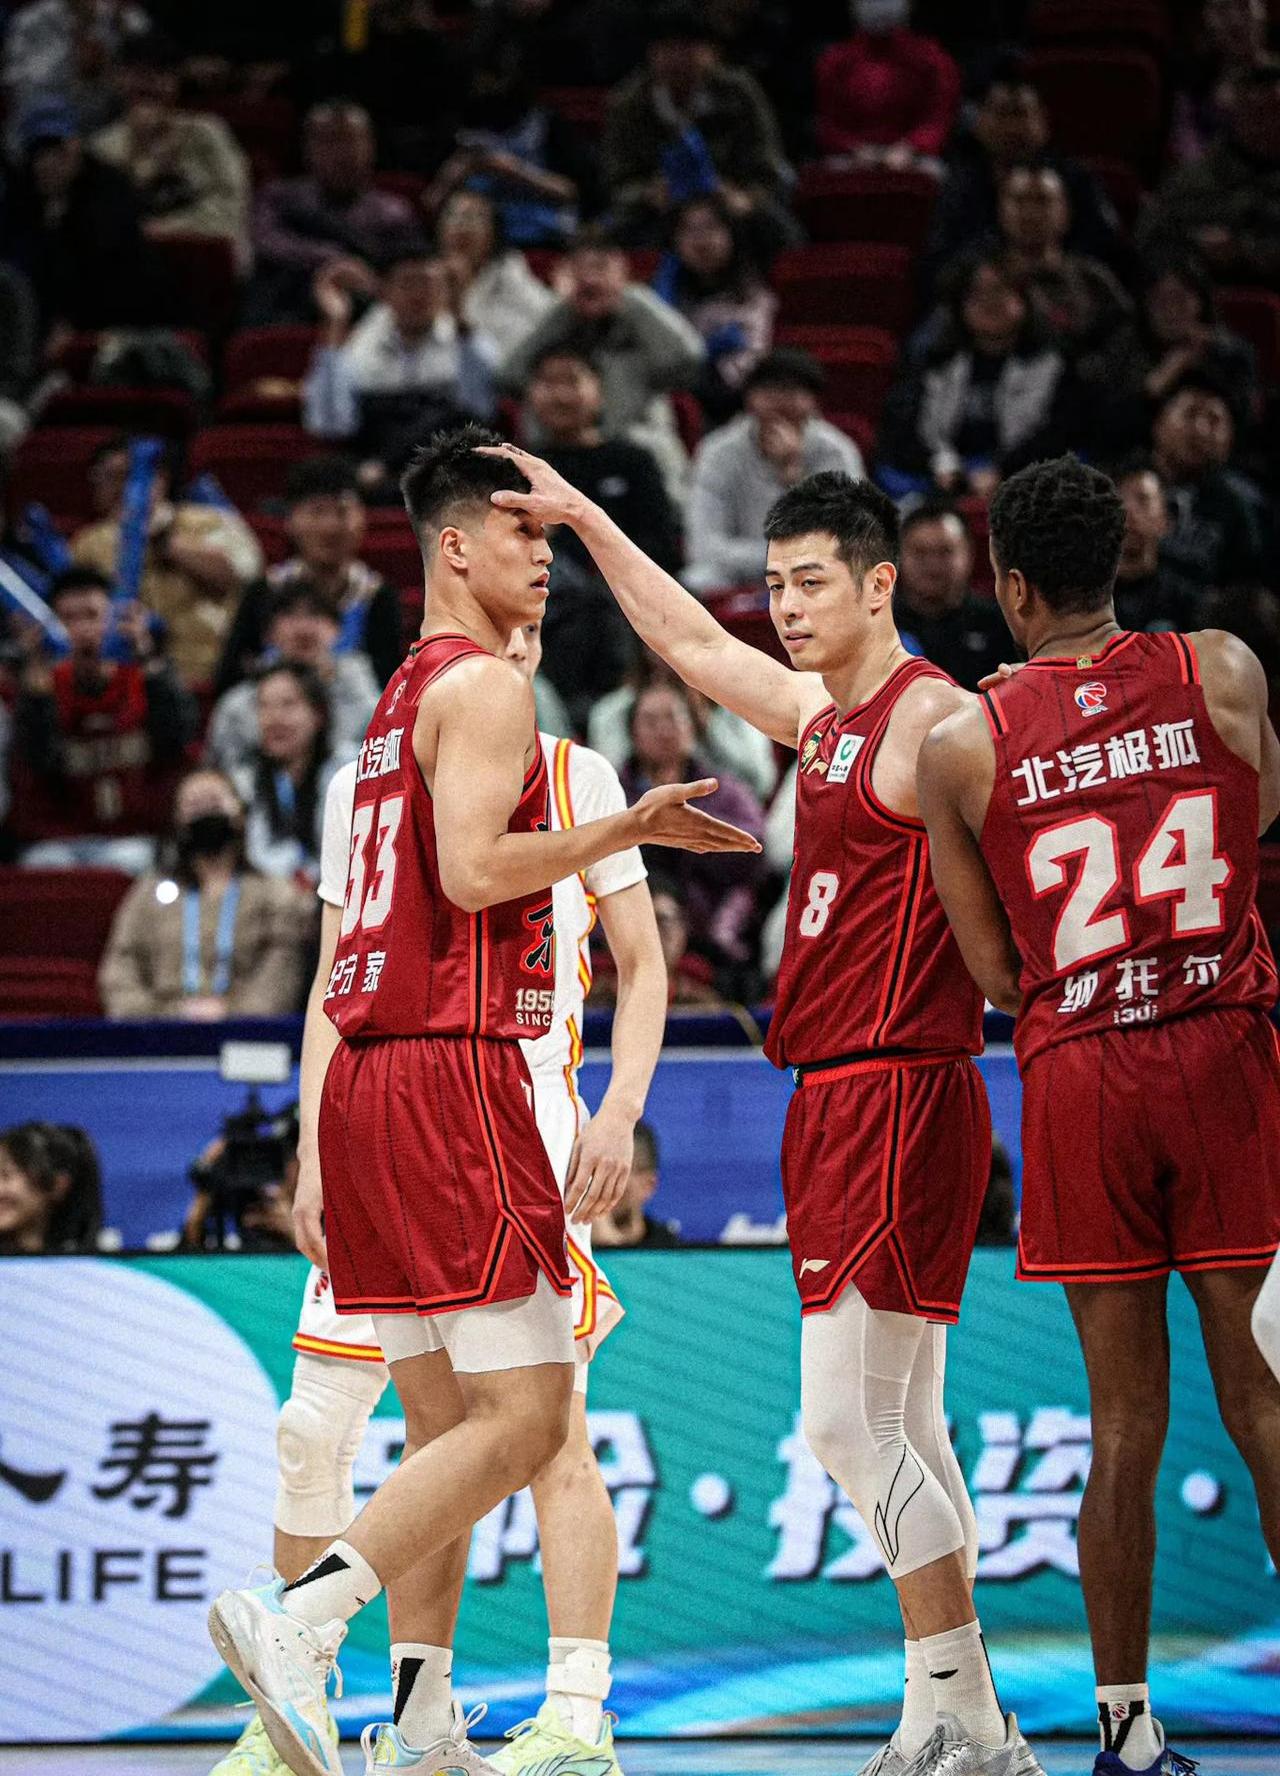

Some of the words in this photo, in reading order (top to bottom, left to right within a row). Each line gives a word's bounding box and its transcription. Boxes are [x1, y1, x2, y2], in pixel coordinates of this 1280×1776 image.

[1011, 719, 1200, 807] 北汽极狐
[340, 793, 406, 941] 33
[1025, 787, 1235, 973] 24
[799, 868, 840, 938] 8
[1057, 954, 1223, 1013] 纳托尔
[515, 1012, 552, 1027] SINC
[1, 1549, 207, 1603] LIFE
